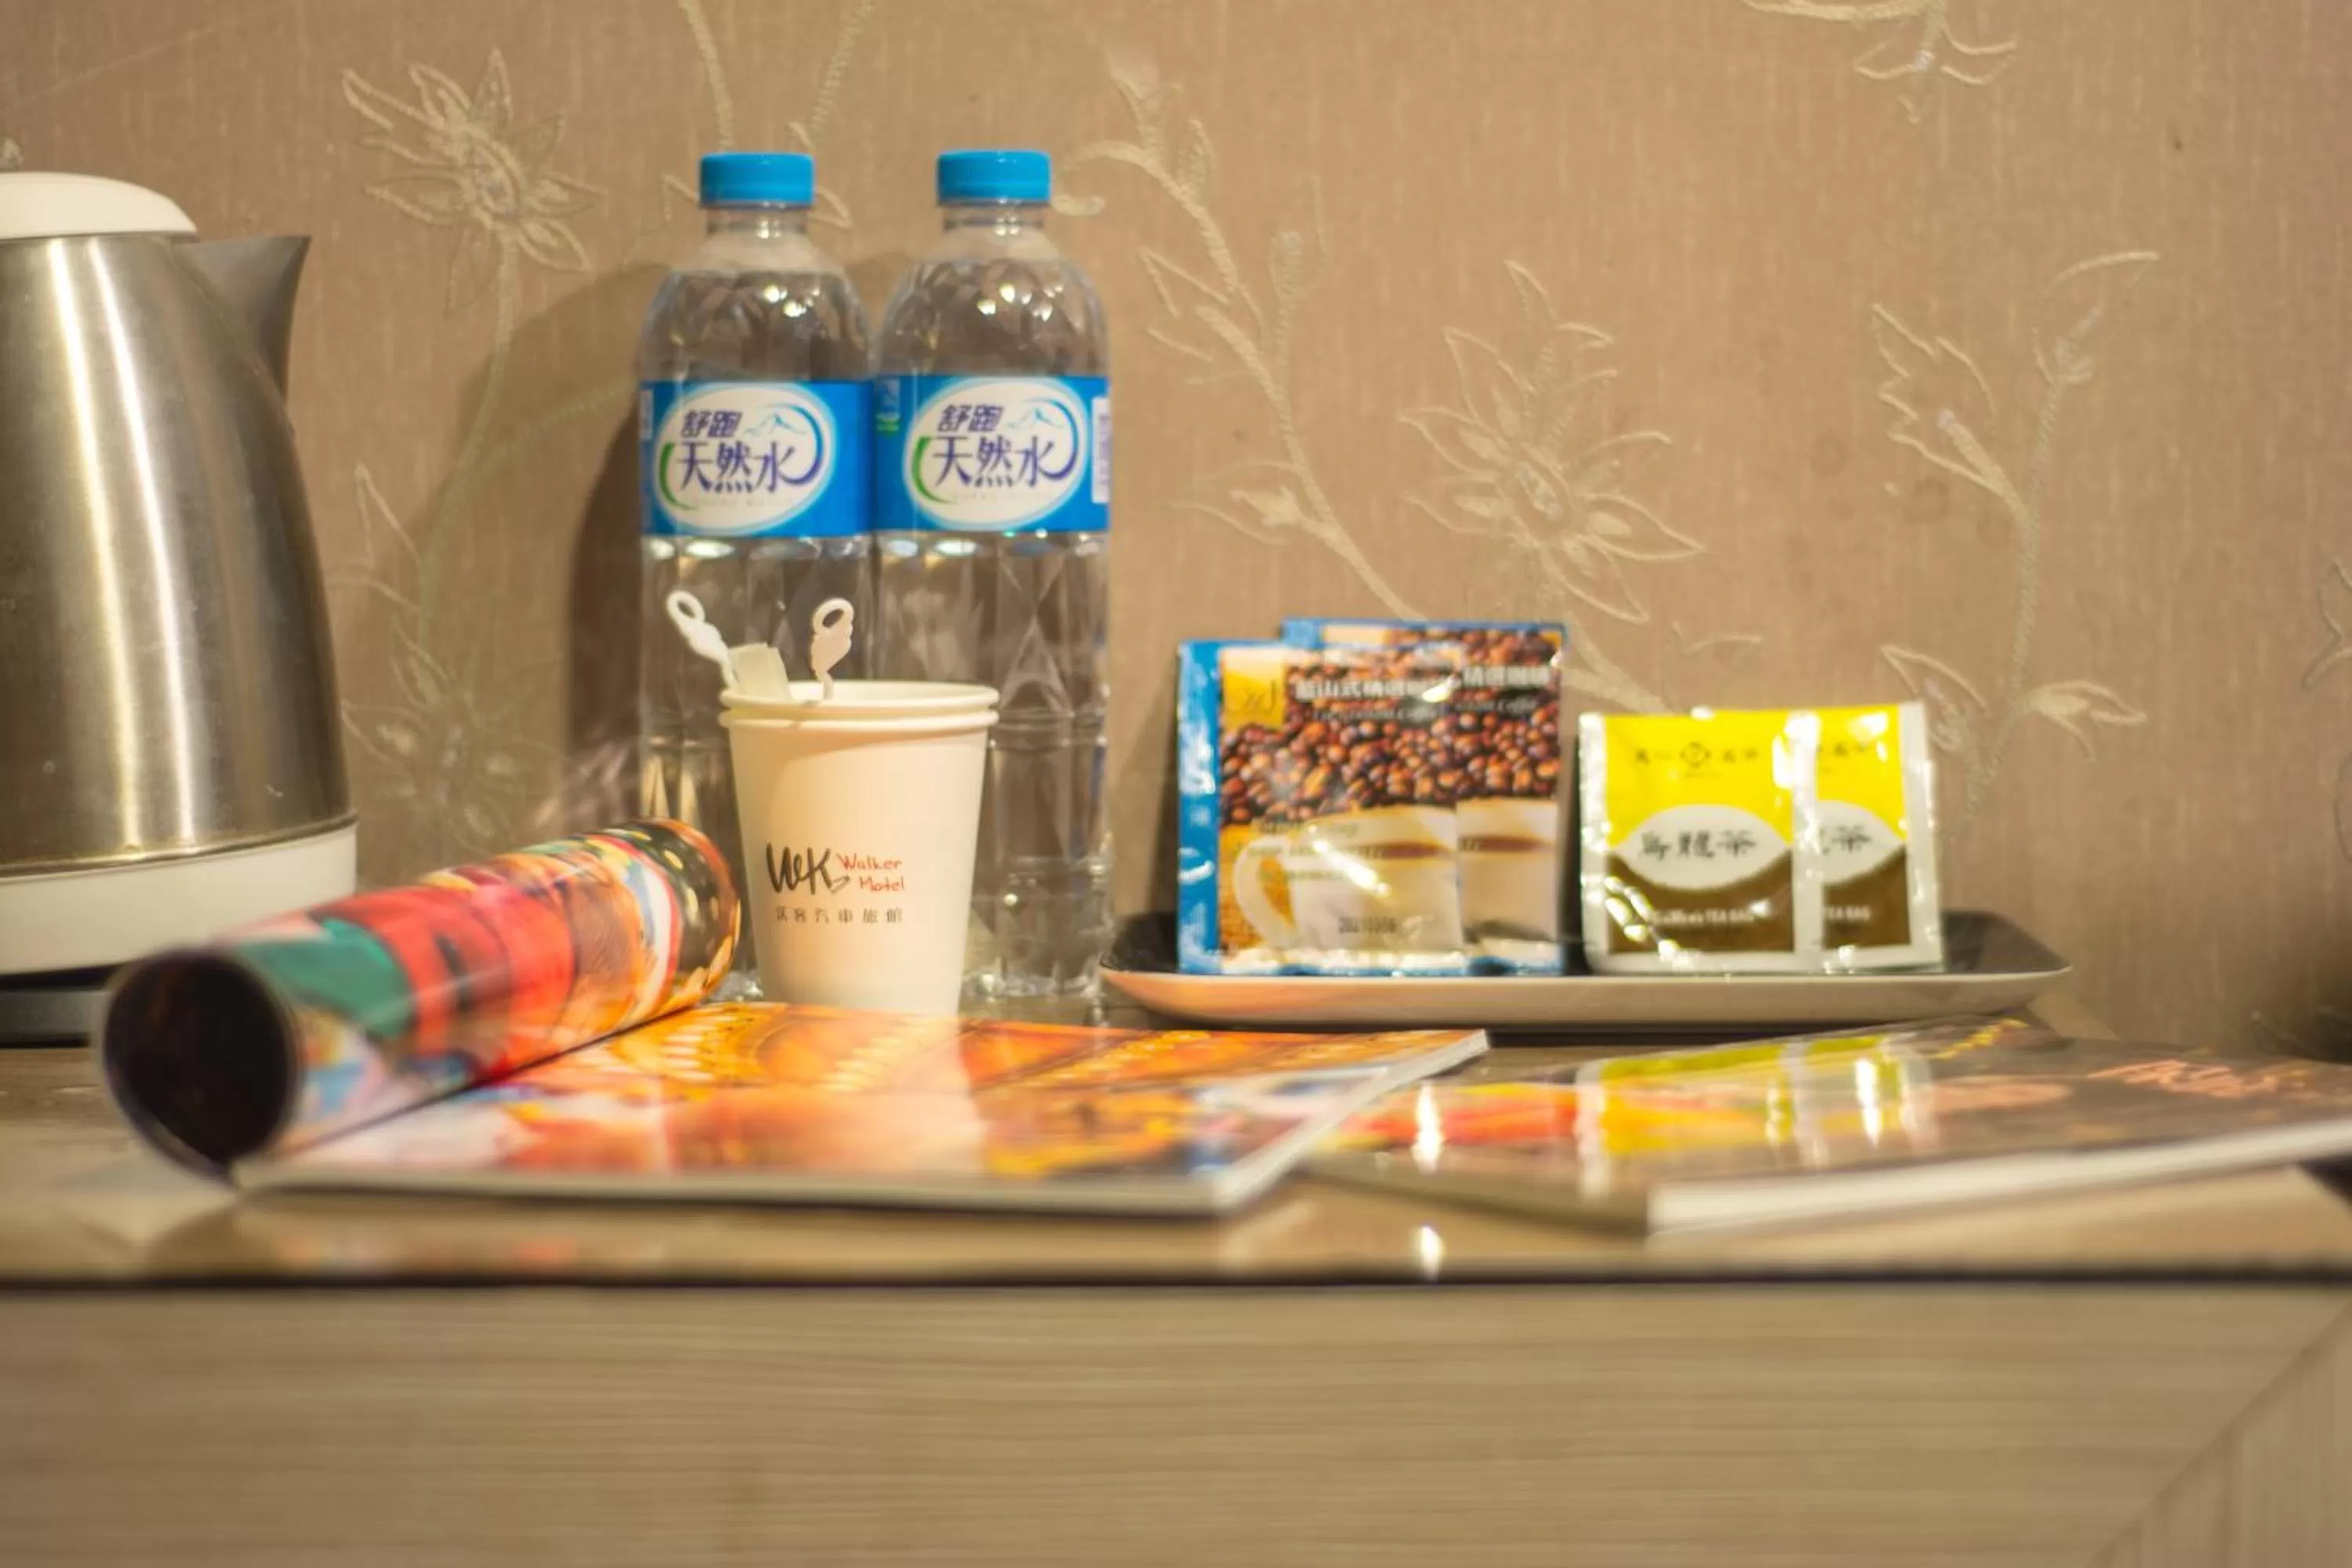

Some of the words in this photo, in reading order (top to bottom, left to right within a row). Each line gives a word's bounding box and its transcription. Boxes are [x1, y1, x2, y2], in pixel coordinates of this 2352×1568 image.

[681, 409, 743, 438] 舒跑
[938, 404, 1004, 433] 舒跑
[677, 439, 798, 494] 天然水
[932, 434, 1058, 488] 天然水
[836, 853, 903, 871] Walker
[859, 876, 906, 892] Motel
